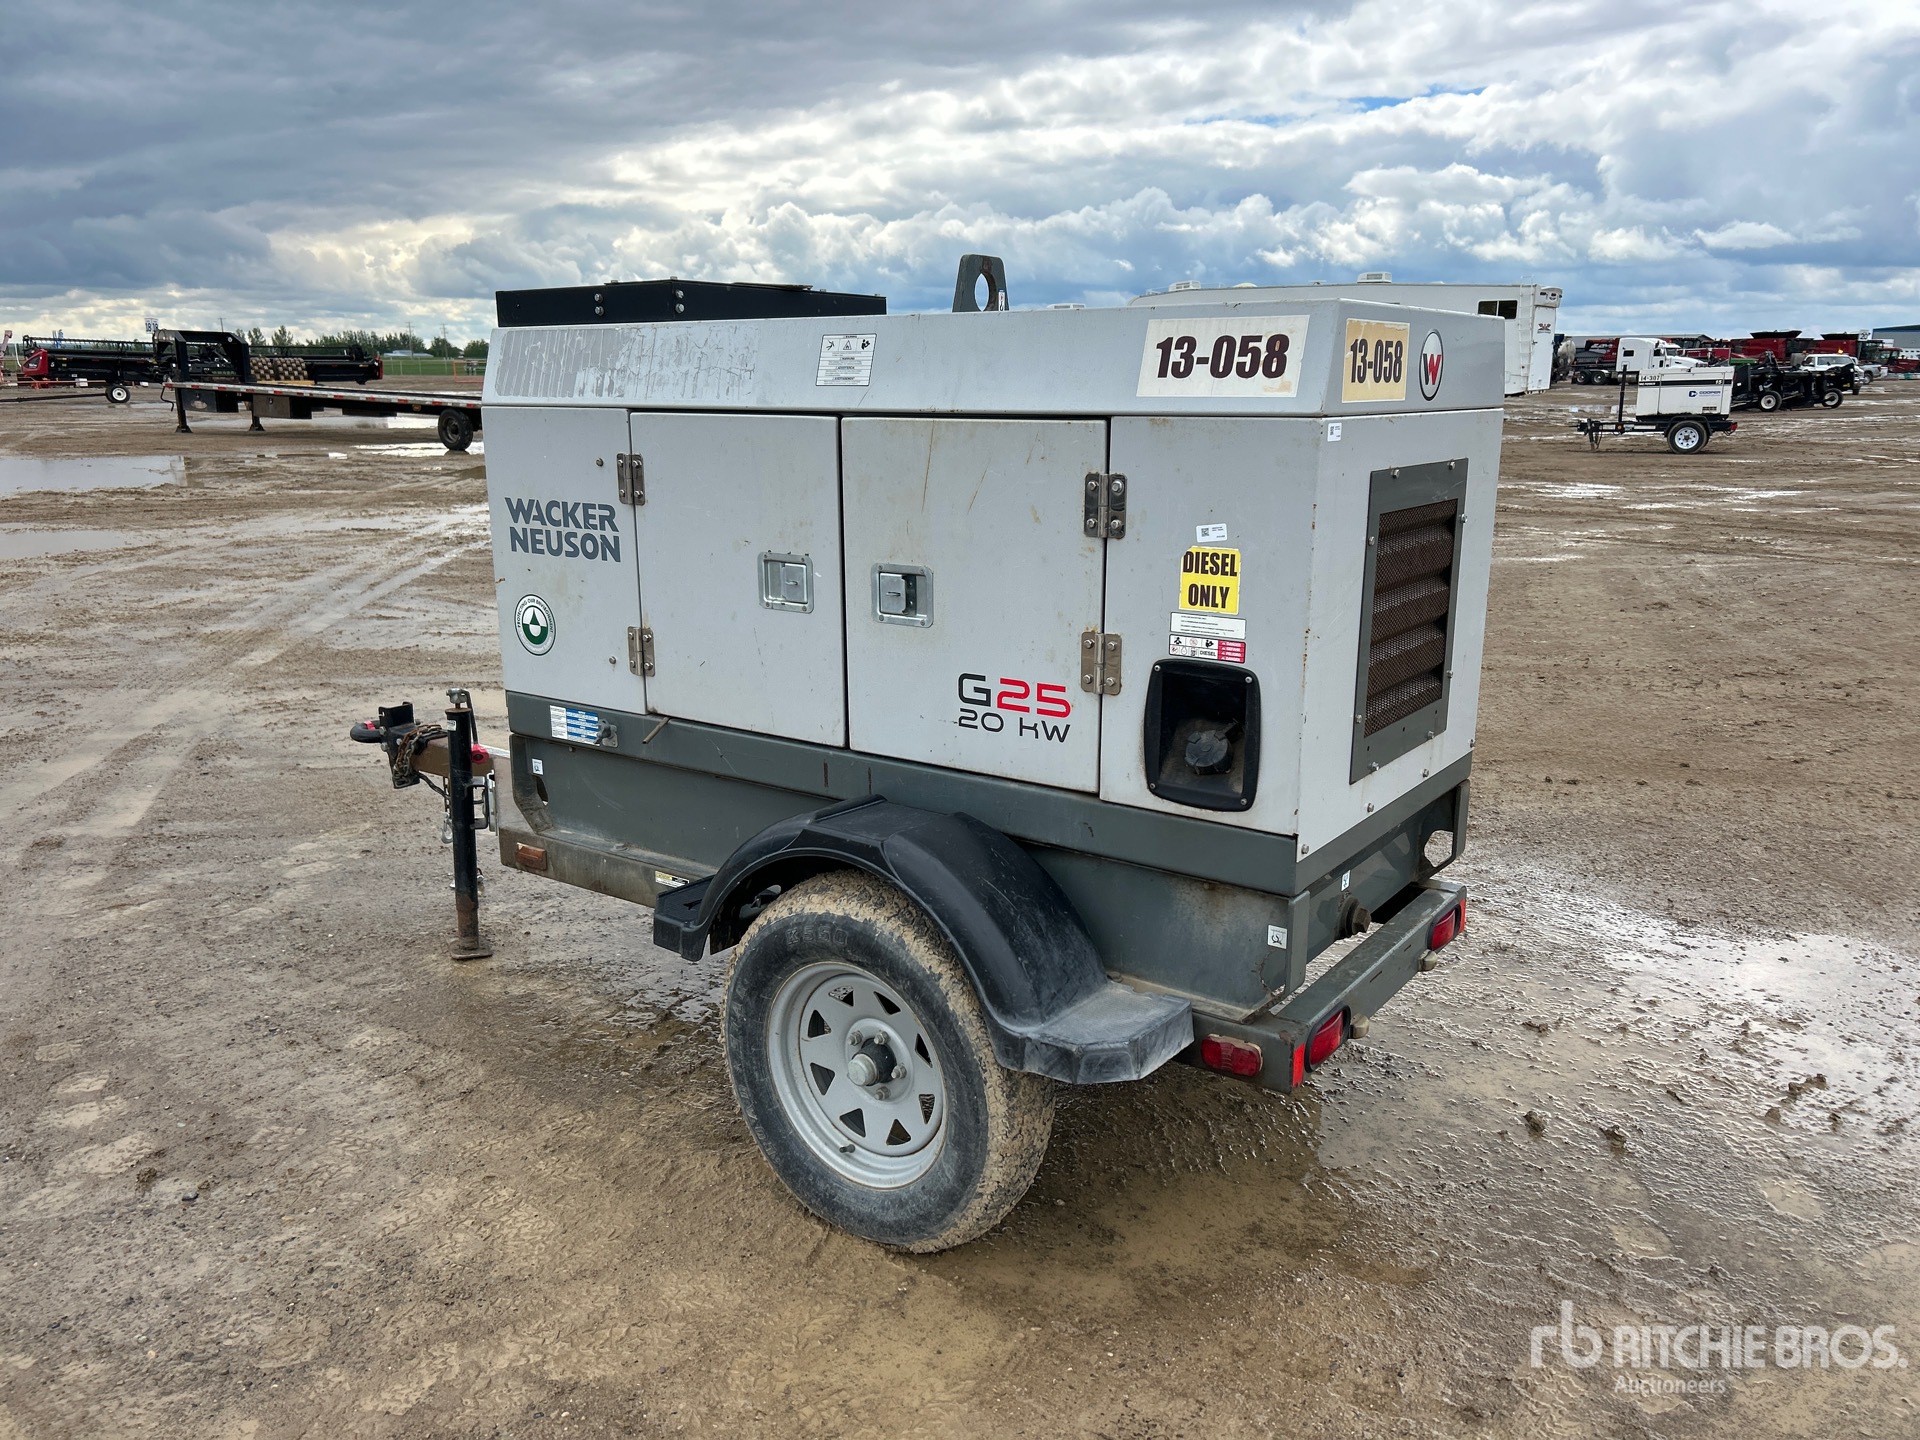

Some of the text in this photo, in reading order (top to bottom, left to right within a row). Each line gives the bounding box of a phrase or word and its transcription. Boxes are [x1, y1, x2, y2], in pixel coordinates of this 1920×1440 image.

[1156, 334, 1290, 379] 13-058
[1350, 338, 1403, 383] 13-058
[504, 497, 619, 532] WACKER
[509, 526, 621, 563] NEUSON
[1183, 551, 1237, 577] DIESEL
[1188, 584, 1230, 609] ONLY
[958, 673, 1071, 718] G25
[959, 708, 1004, 732] 20
